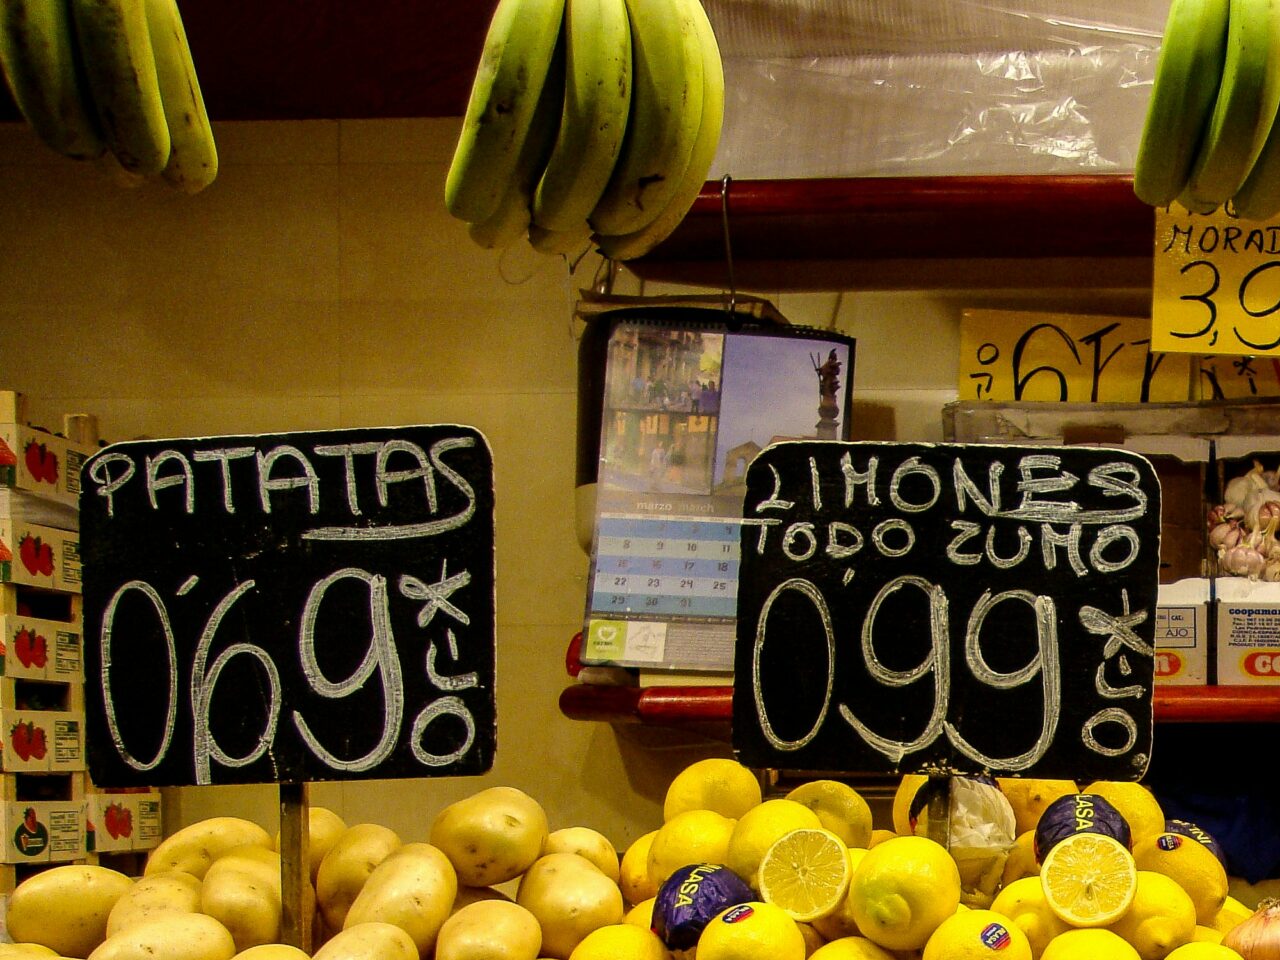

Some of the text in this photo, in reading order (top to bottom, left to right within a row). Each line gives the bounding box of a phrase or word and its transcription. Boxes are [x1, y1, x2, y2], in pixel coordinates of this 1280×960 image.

[89, 438, 478, 541] PATATAS
[756, 451, 1148, 524] LIMONES
[687, 543, 697, 552] 10
[722, 544, 731, 553] 11
[717, 562, 728, 572] 18
[741, 517, 1140, 577] TODO ZUMO
[614, 577, 727, 590] 22 23 24 25
[1166, 629, 1188, 637] AJO
[100, 567, 404, 786] 0'69
[752, 567, 1061, 772] 0'99
